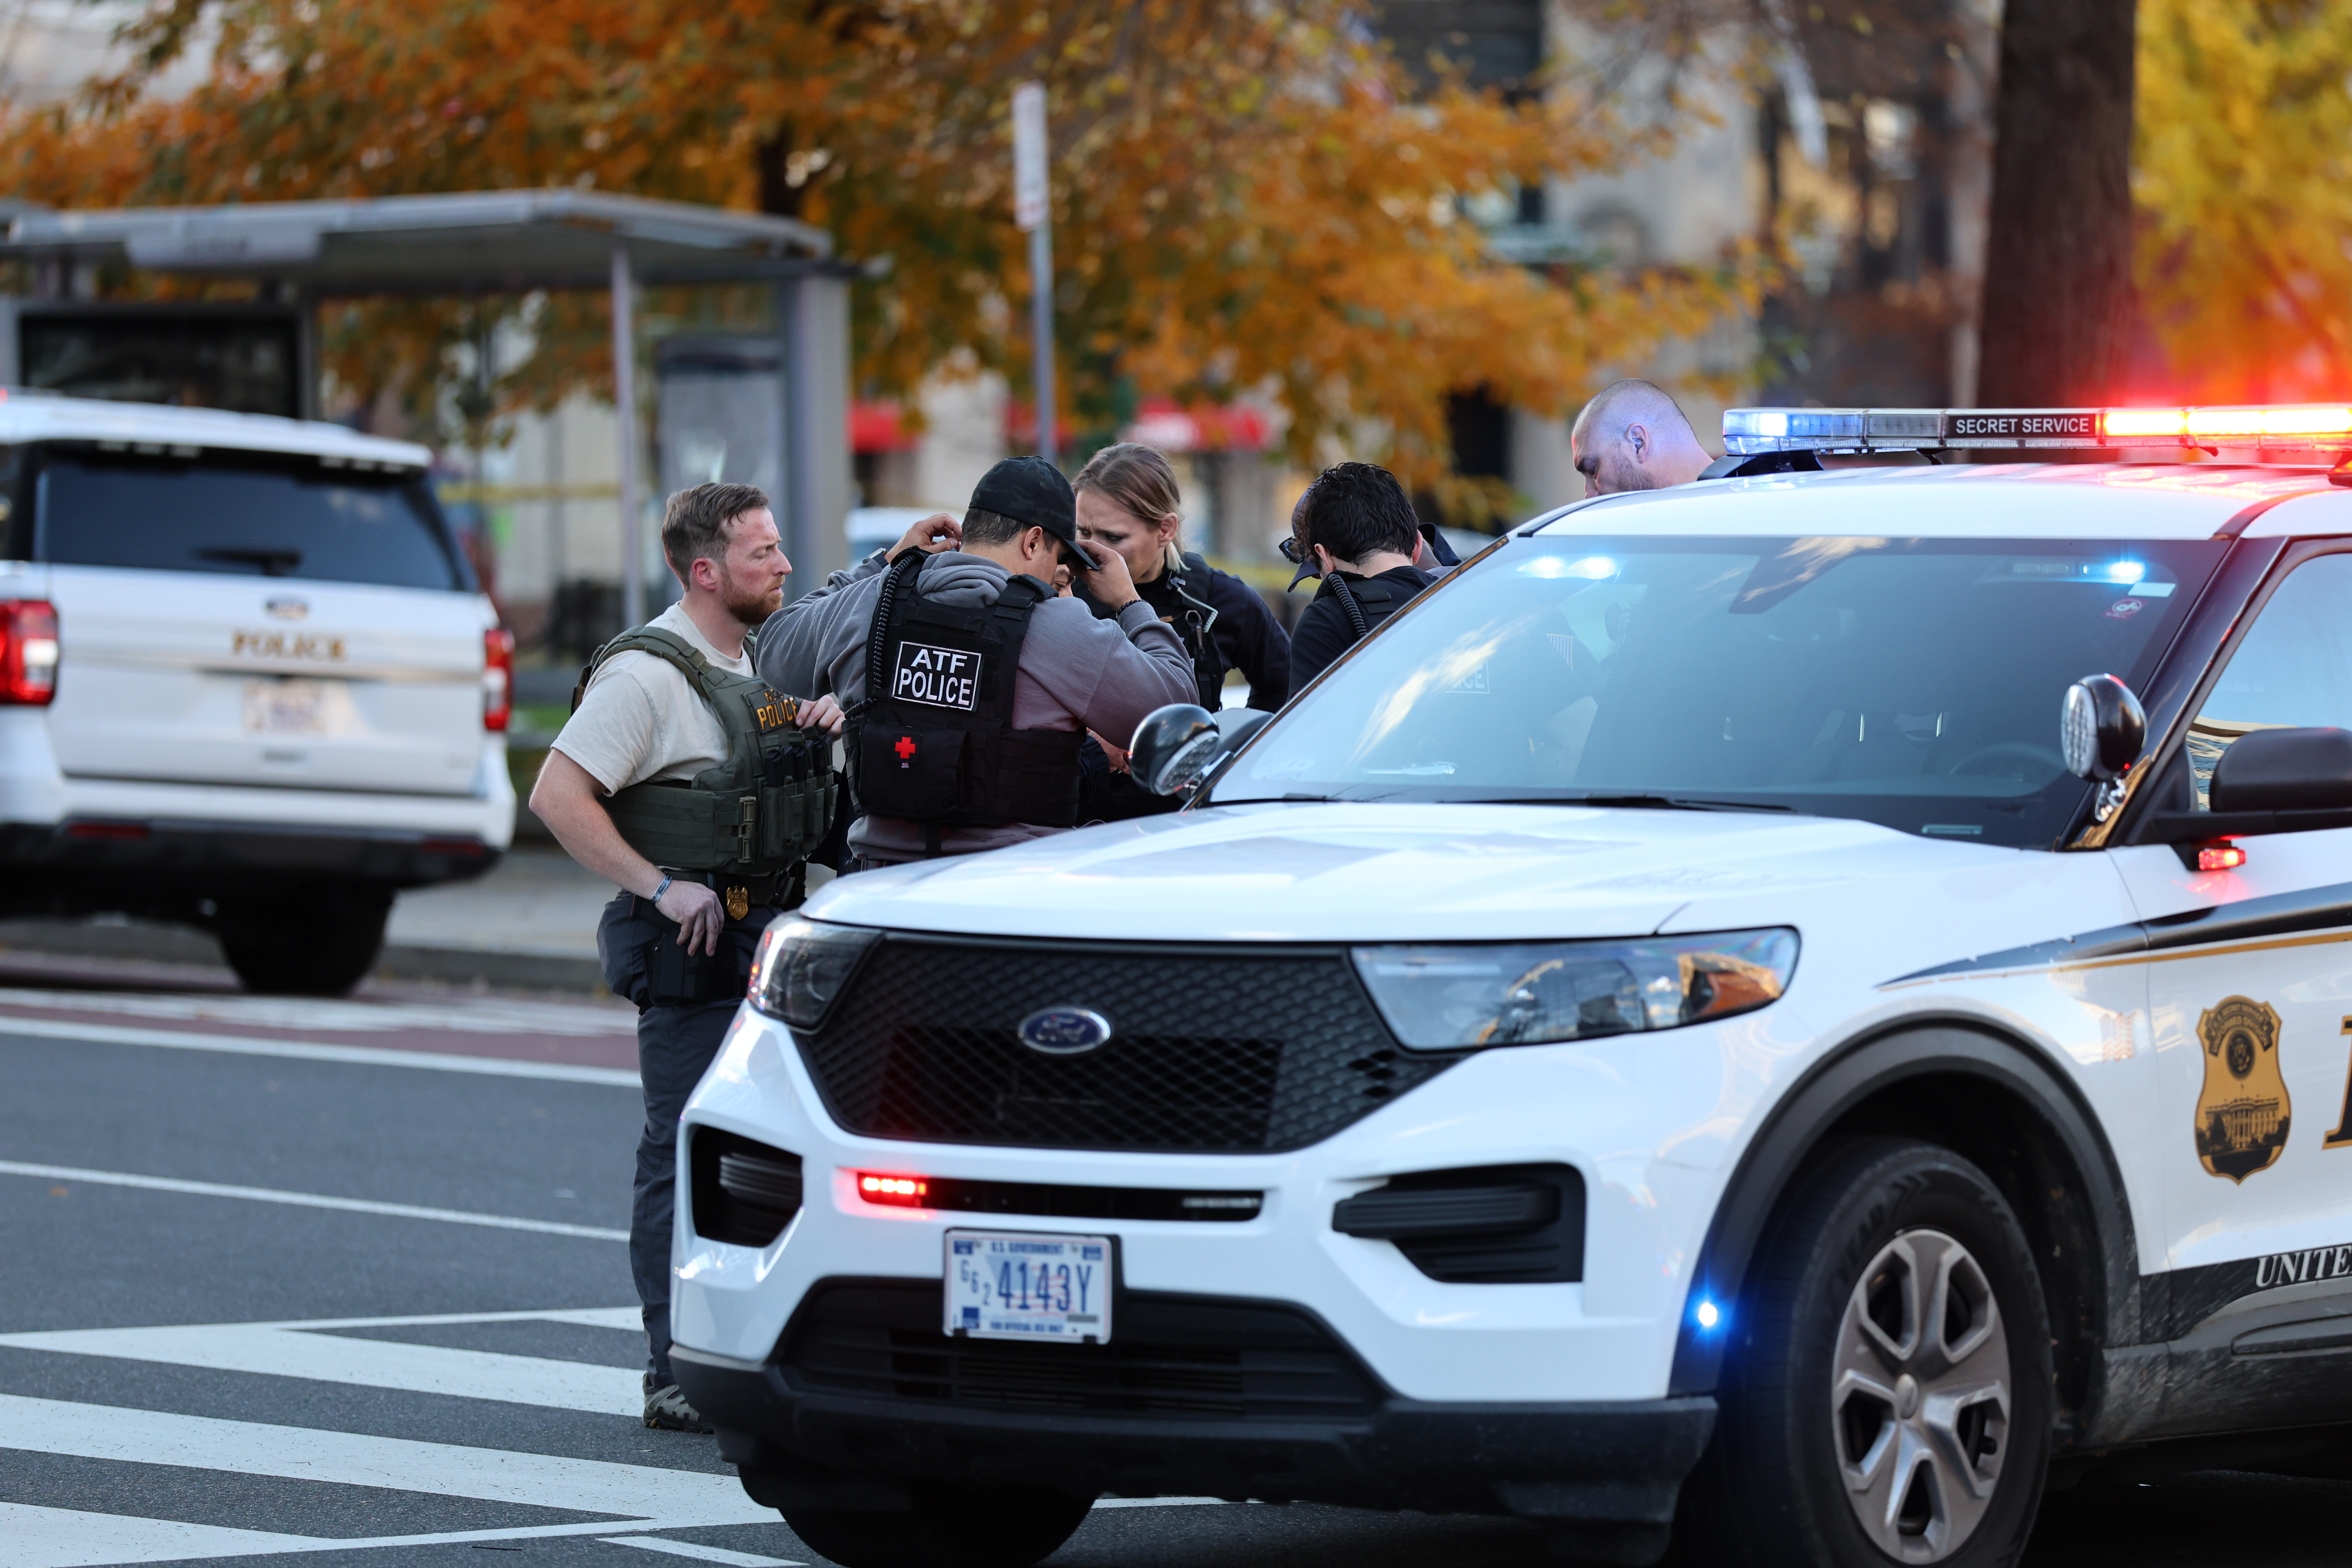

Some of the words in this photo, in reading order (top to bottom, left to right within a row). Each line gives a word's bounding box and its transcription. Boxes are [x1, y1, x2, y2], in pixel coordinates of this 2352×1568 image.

[1956, 418, 2018, 434] SECRET
[2022, 417, 2089, 433] SERVICE
[910, 648, 968, 674] ATF
[898, 668, 973, 706] POLICE
[756, 697, 797, 731] POLICE
[2243, 1015, 2268, 1046] DIVISION
[2256, 1244, 2352, 1288] UNITE
[998, 1260, 1093, 1312] 4143Y
